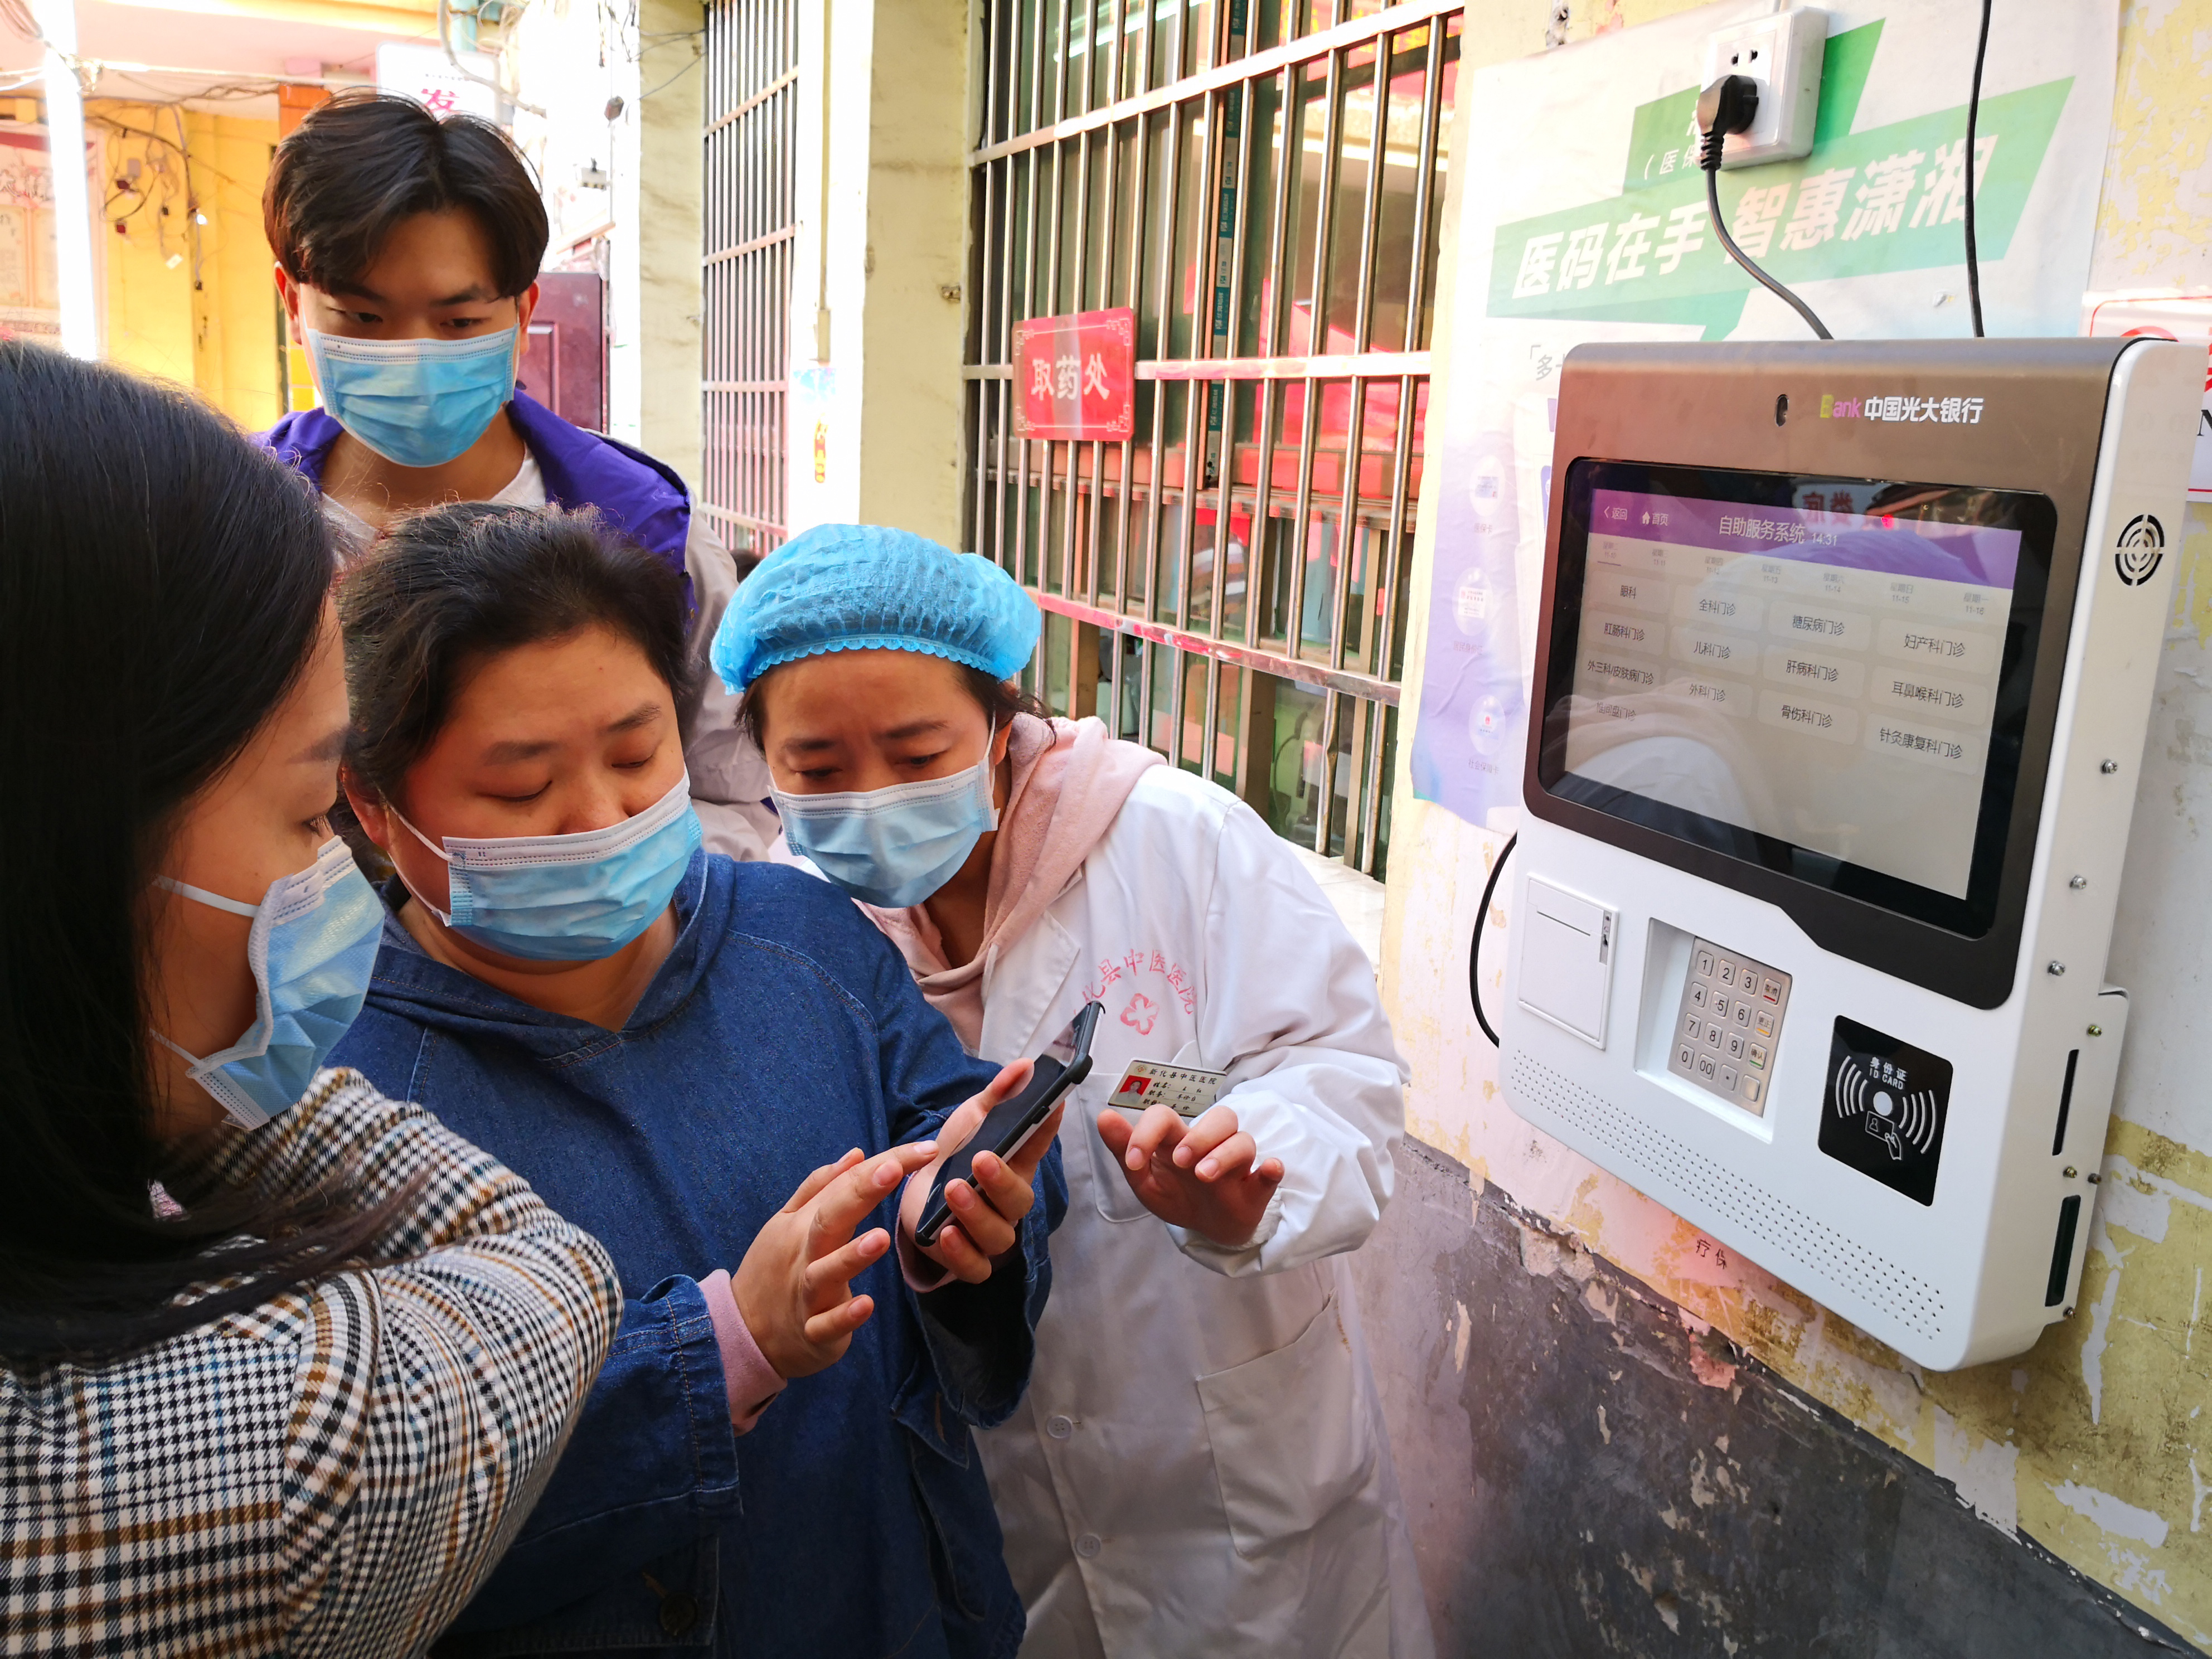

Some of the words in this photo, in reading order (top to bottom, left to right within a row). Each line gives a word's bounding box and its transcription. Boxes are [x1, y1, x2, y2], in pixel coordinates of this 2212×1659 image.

[1512, 202, 1709, 299] 医码在手
[1724, 134, 1998, 263] 智惠潇湘
[1031, 353, 1110, 401] 取药处
[1864, 396, 1984, 424] 中国光大银行
[1611, 507, 1628, 521] 返回
[1652, 512, 1669, 526] 首页
[1719, 516, 1806, 544] 自助服务系统
[1812, 532, 1837, 546] 14:31
[1621, 585, 1637, 599] 眼科
[1892, 595, 1909, 604] 11-15
[1699, 599, 1736, 616] 全科门诊
[1604, 623, 1645, 641] 肛肠科门诊
[1792, 615, 1845, 636] 糖尿病门诊
[1694, 641, 1731, 659] 儿科门诊
[1904, 634, 1965, 657] 妇产科门诊
[1786, 659, 1839, 682] 肝病科门诊
[1689, 683, 1726, 702] 外科门诊
[1891, 681, 1964, 709] 耳鼻喉科门诊
[1781, 705, 1833, 728] 骨伤科门诊
[1880, 727, 1963, 759] 针灸康复科门诊
[1702, 959, 1707, 970] 1
[1723, 968, 1730, 979] 2
[1074, 948, 1197, 1015] 化县中医医院
[1744, 977, 1752, 988] 3
[1695, 991, 1701, 1002] 4
[1718, 1000, 1724, 1011] 5
[1738, 1008, 1744, 1021] 6
[1689, 1020, 1695, 1032] 7
[1709, 1030, 1716, 1042] 8
[1731, 1040, 1738, 1052] 9
[1681, 1051, 1689, 1063] 0
[1699, 1060, 1713, 1075] 00
[1870, 1057, 1908, 1081] 身份证
[1870, 1068, 1878, 1078] ID
[1882, 1074, 1903, 1090] CARD
